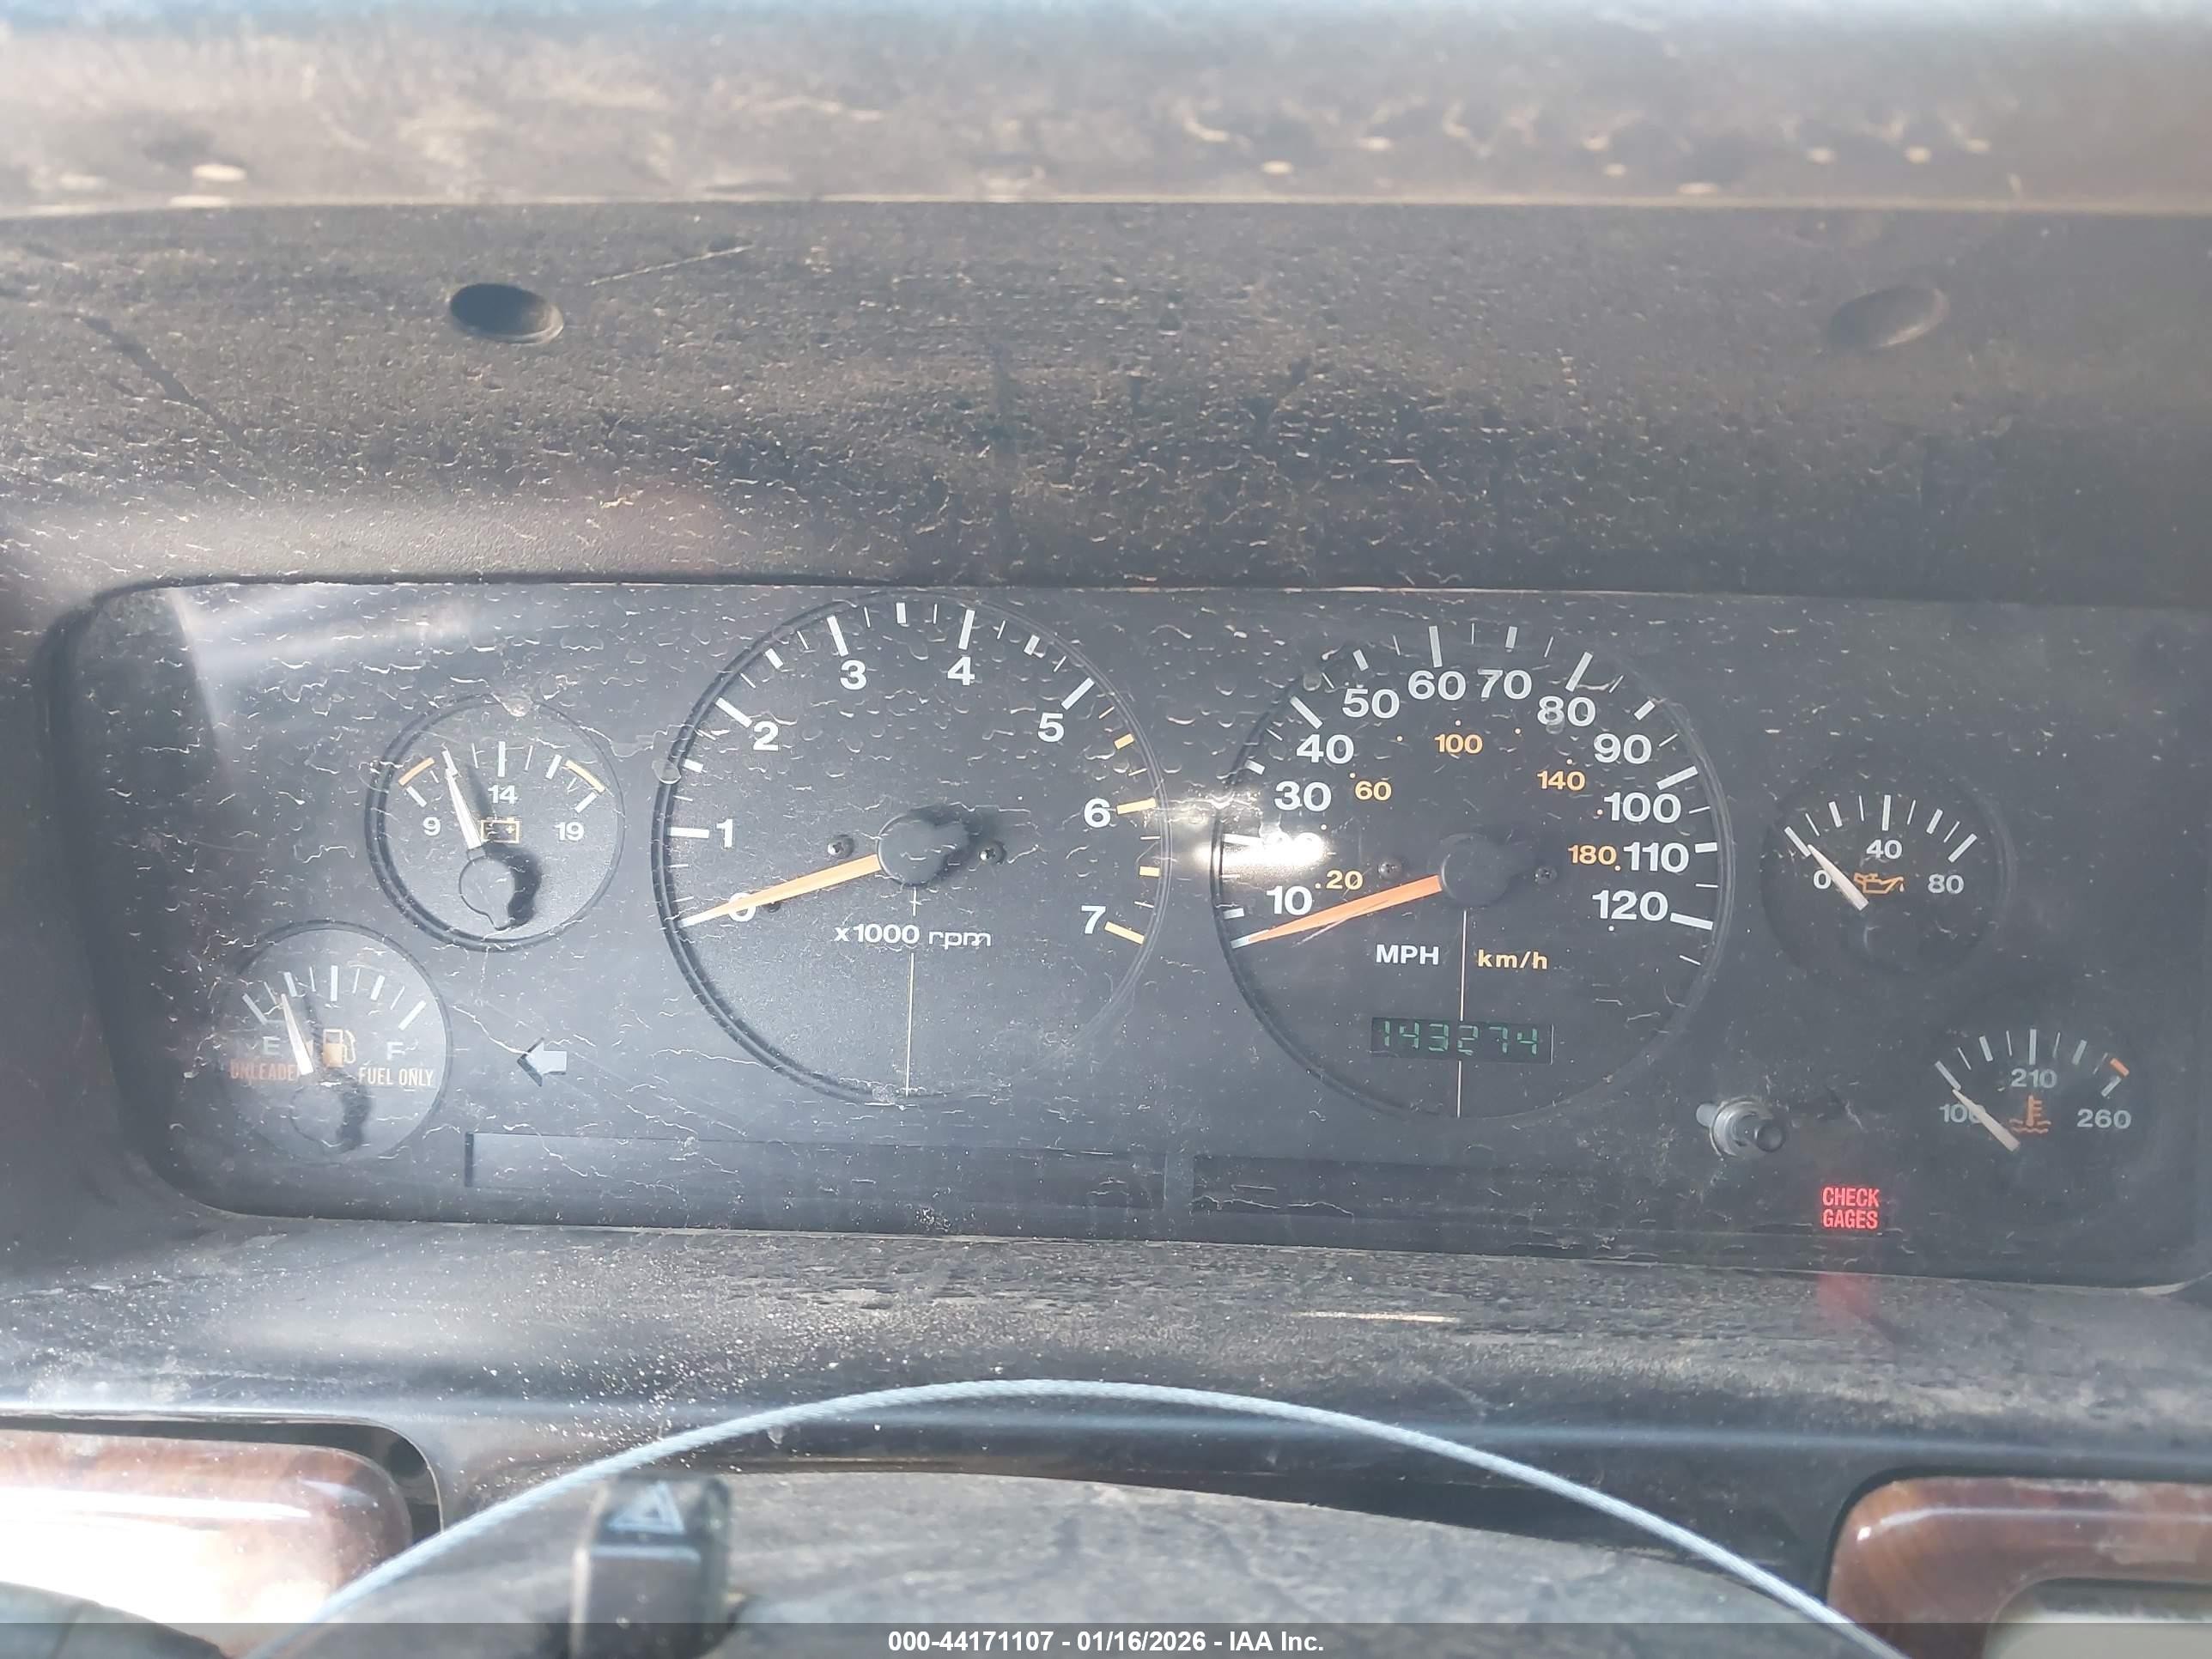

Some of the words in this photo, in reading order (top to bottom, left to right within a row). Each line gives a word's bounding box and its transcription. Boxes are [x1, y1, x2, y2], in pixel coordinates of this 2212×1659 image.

[840, 659, 867, 690] 3
[947, 656, 975, 686] 4
[1476, 669, 1533, 700] 70
[1407, 671, 1468, 701] 60
[1342, 688, 1400, 719] 50
[1537, 696, 1596, 726] 80
[753, 721, 779, 751] 2
[1037, 713, 1065, 743] 5
[1296, 734, 1354, 764] 40
[1434, 733, 1483, 754] 100
[1593, 733, 1652, 764] 90
[1354, 781, 1392, 801] 60
[1536, 770, 1586, 791] 140
[488, 785, 517, 805] 14
[1274, 781, 1332, 811] 30
[1603, 793, 1682, 823] 100
[422, 817, 441, 836] 9
[1084, 798, 1111, 828] 6
[556, 822, 585, 842] 19
[716, 818, 732, 848] 1
[1568, 844, 1617, 865] 180
[1623, 842, 1689, 873] 110
[1866, 839, 1903, 860] 40
[1326, 870, 1364, 890] 20
[1813, 869, 1832, 890] 0
[1928, 873, 1964, 895] 80
[729, 892, 757, 922] 0
[1266, 885, 1314, 915] 10
[1592, 890, 1668, 921] 120
[1081, 906, 1106, 934] 7
[834, 923, 921, 945] x1000
[929, 928, 993, 950] rpm
[1376, 944, 1439, 965] MPH
[1477, 948, 1548, 969] km/h
[263, 1036, 281, 1055] E
[387, 1041, 405, 1061] F
[1383, 1020, 1538, 1056] 143274
[229, 1057, 301, 1081] UNLEADE
[359, 1066, 394, 1086] FUEL
[398, 1066, 434, 1087] ONLY
[2011, 1068, 2057, 1089] 210
[2076, 1108, 2132, 1130] 260
[1821, 1186, 1881, 1207] CHECK
[1822, 1209, 1879, 1230] GAGES
